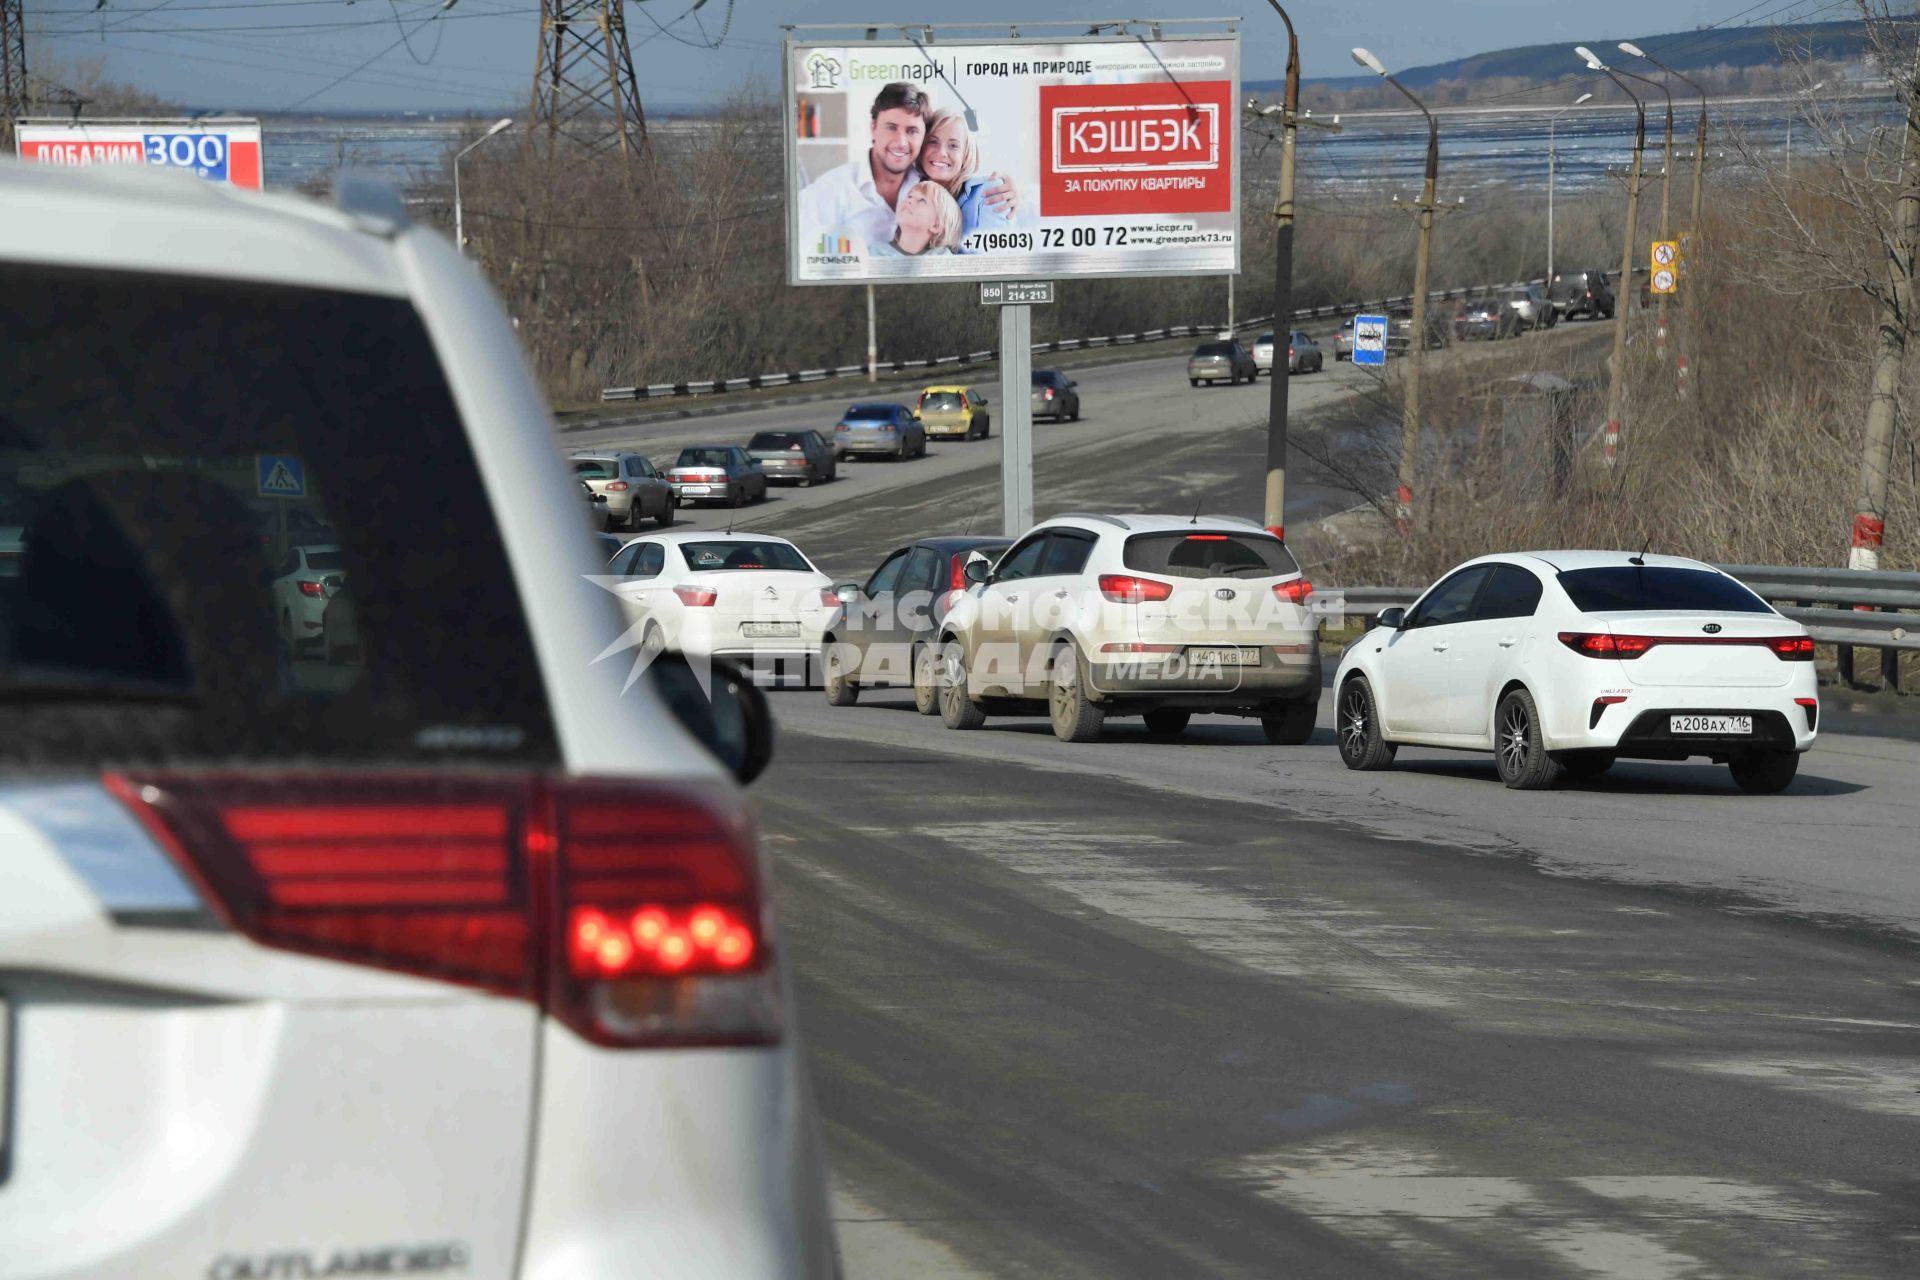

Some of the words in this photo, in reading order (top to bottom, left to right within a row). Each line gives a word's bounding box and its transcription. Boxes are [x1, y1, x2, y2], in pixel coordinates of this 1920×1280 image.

[966, 61, 1009, 77] ГОРОД
[1012, 61, 1028, 75] НА
[1033, 60, 1092, 75] ПРИРОДЕ
[1069, 118, 1202, 153] КЭШБЭК
[1064, 179, 1081, 193] ЗА
[1083, 178, 1139, 192] ПОКУПКУ
[1141, 177, 1206, 191] КВАРТИРЫ
[1130, 223, 1193, 234] www.iccpr.ru
[963, 232, 1033, 251] +7(9603)
[1040, 228, 1065, 247] 72
[1072, 227, 1096, 246] 00
[1103, 226, 1127, 245] 72
[1130, 233, 1232, 245] www.greenpark73.ru
[983, 287, 1001, 298] 850
[1704, 624, 1721, 633] KIA
